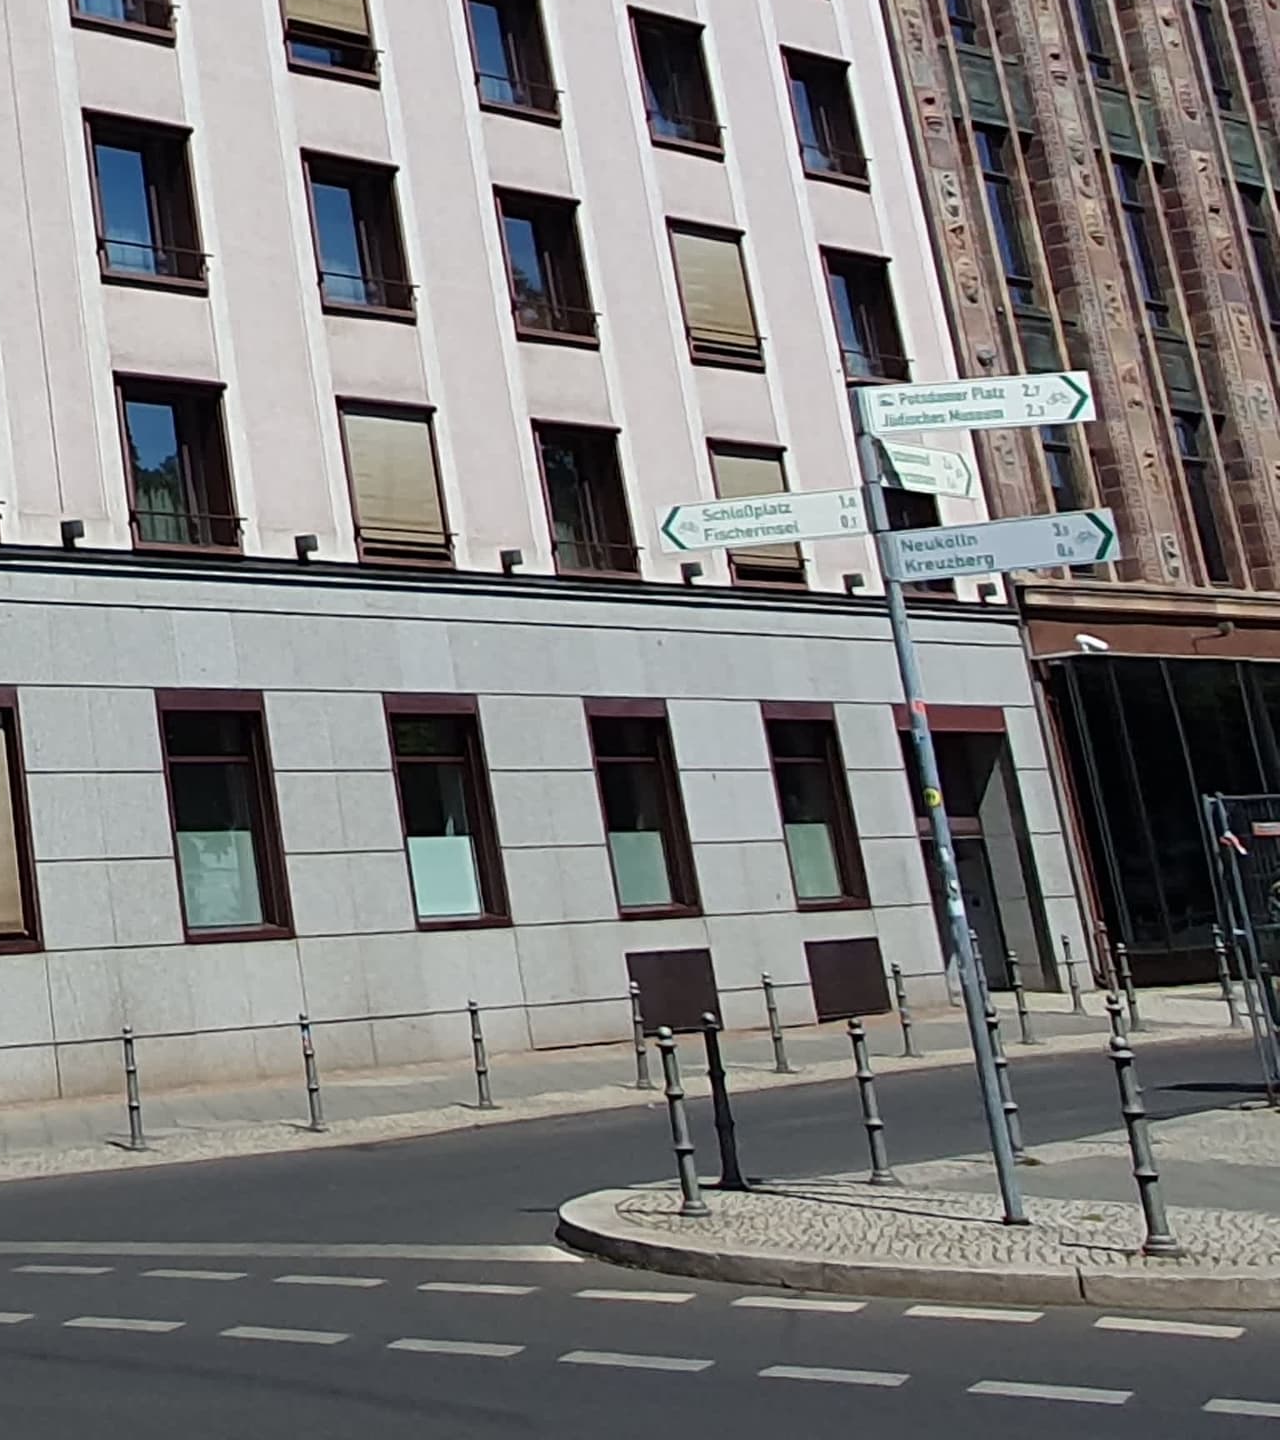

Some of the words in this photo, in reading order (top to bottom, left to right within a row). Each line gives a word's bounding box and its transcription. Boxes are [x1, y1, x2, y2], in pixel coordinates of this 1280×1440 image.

[701, 503, 793, 523] Schloßplatz
[704, 520, 800, 541] Fischerinsel
[900, 534, 978, 553] Neukölln
[904, 552, 995, 574] Kreuzberg
